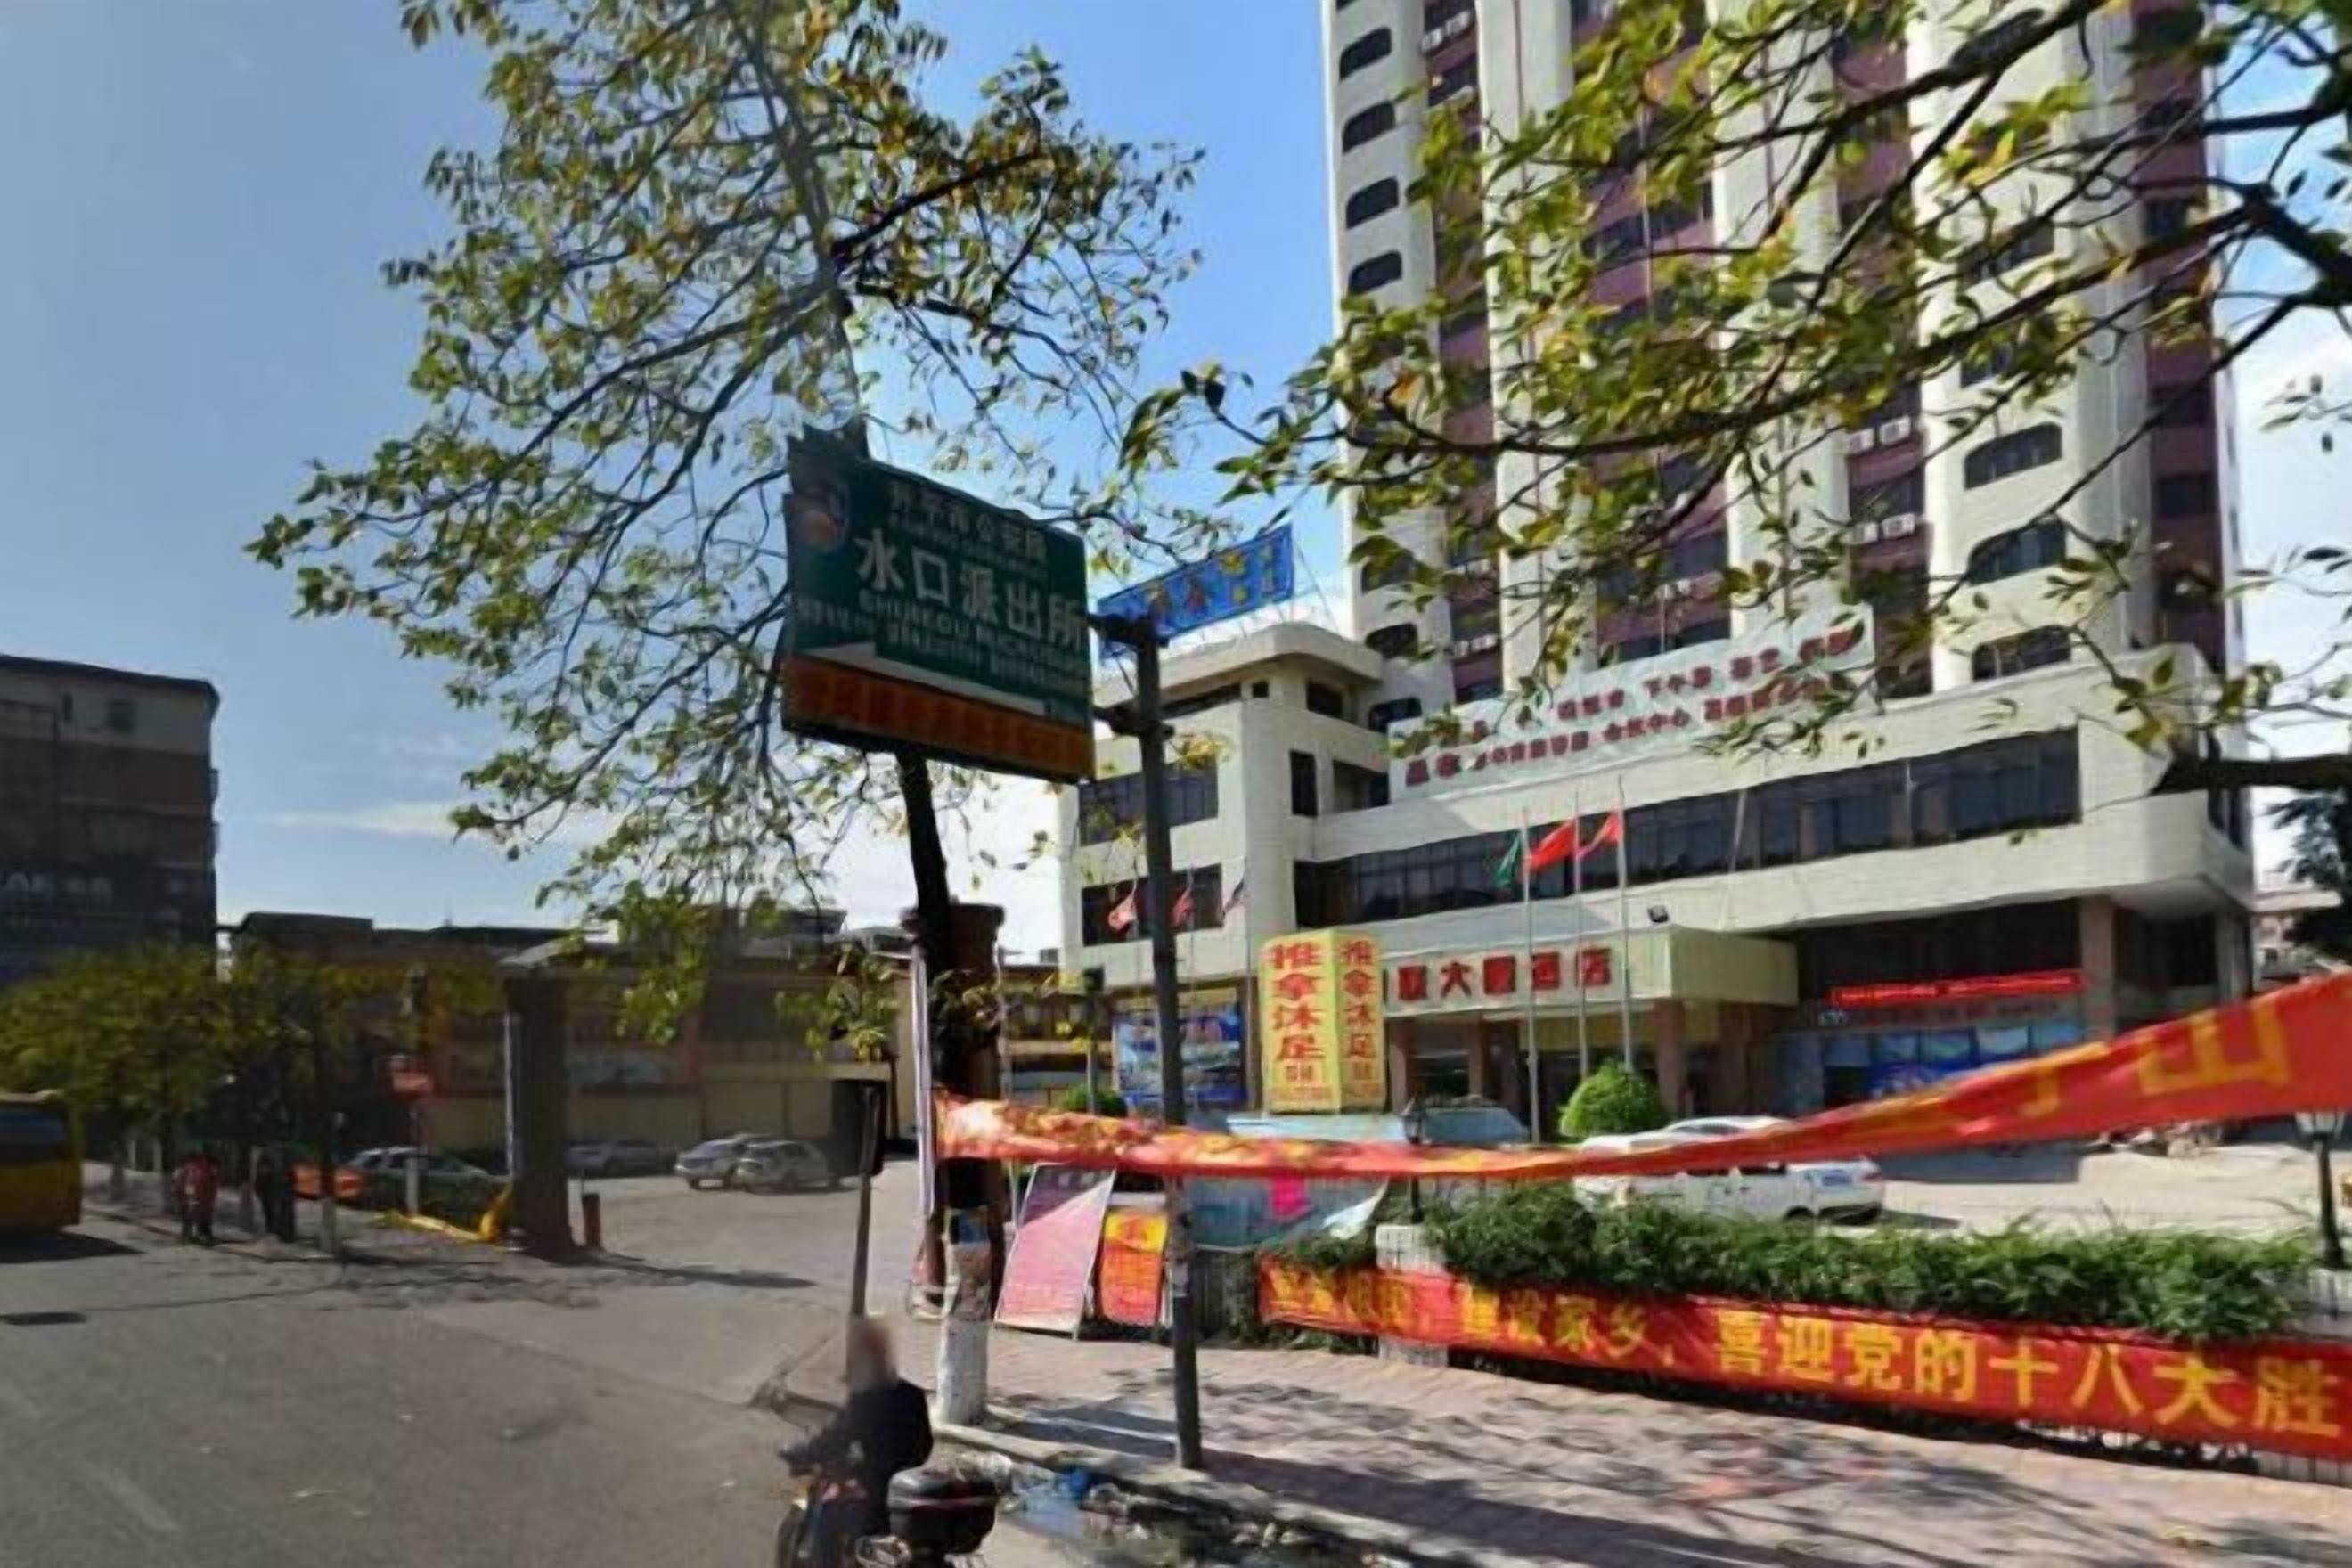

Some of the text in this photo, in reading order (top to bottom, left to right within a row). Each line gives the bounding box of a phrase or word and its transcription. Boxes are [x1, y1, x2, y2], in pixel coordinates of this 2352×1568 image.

[853, 527, 1086, 649] 水口派出所
